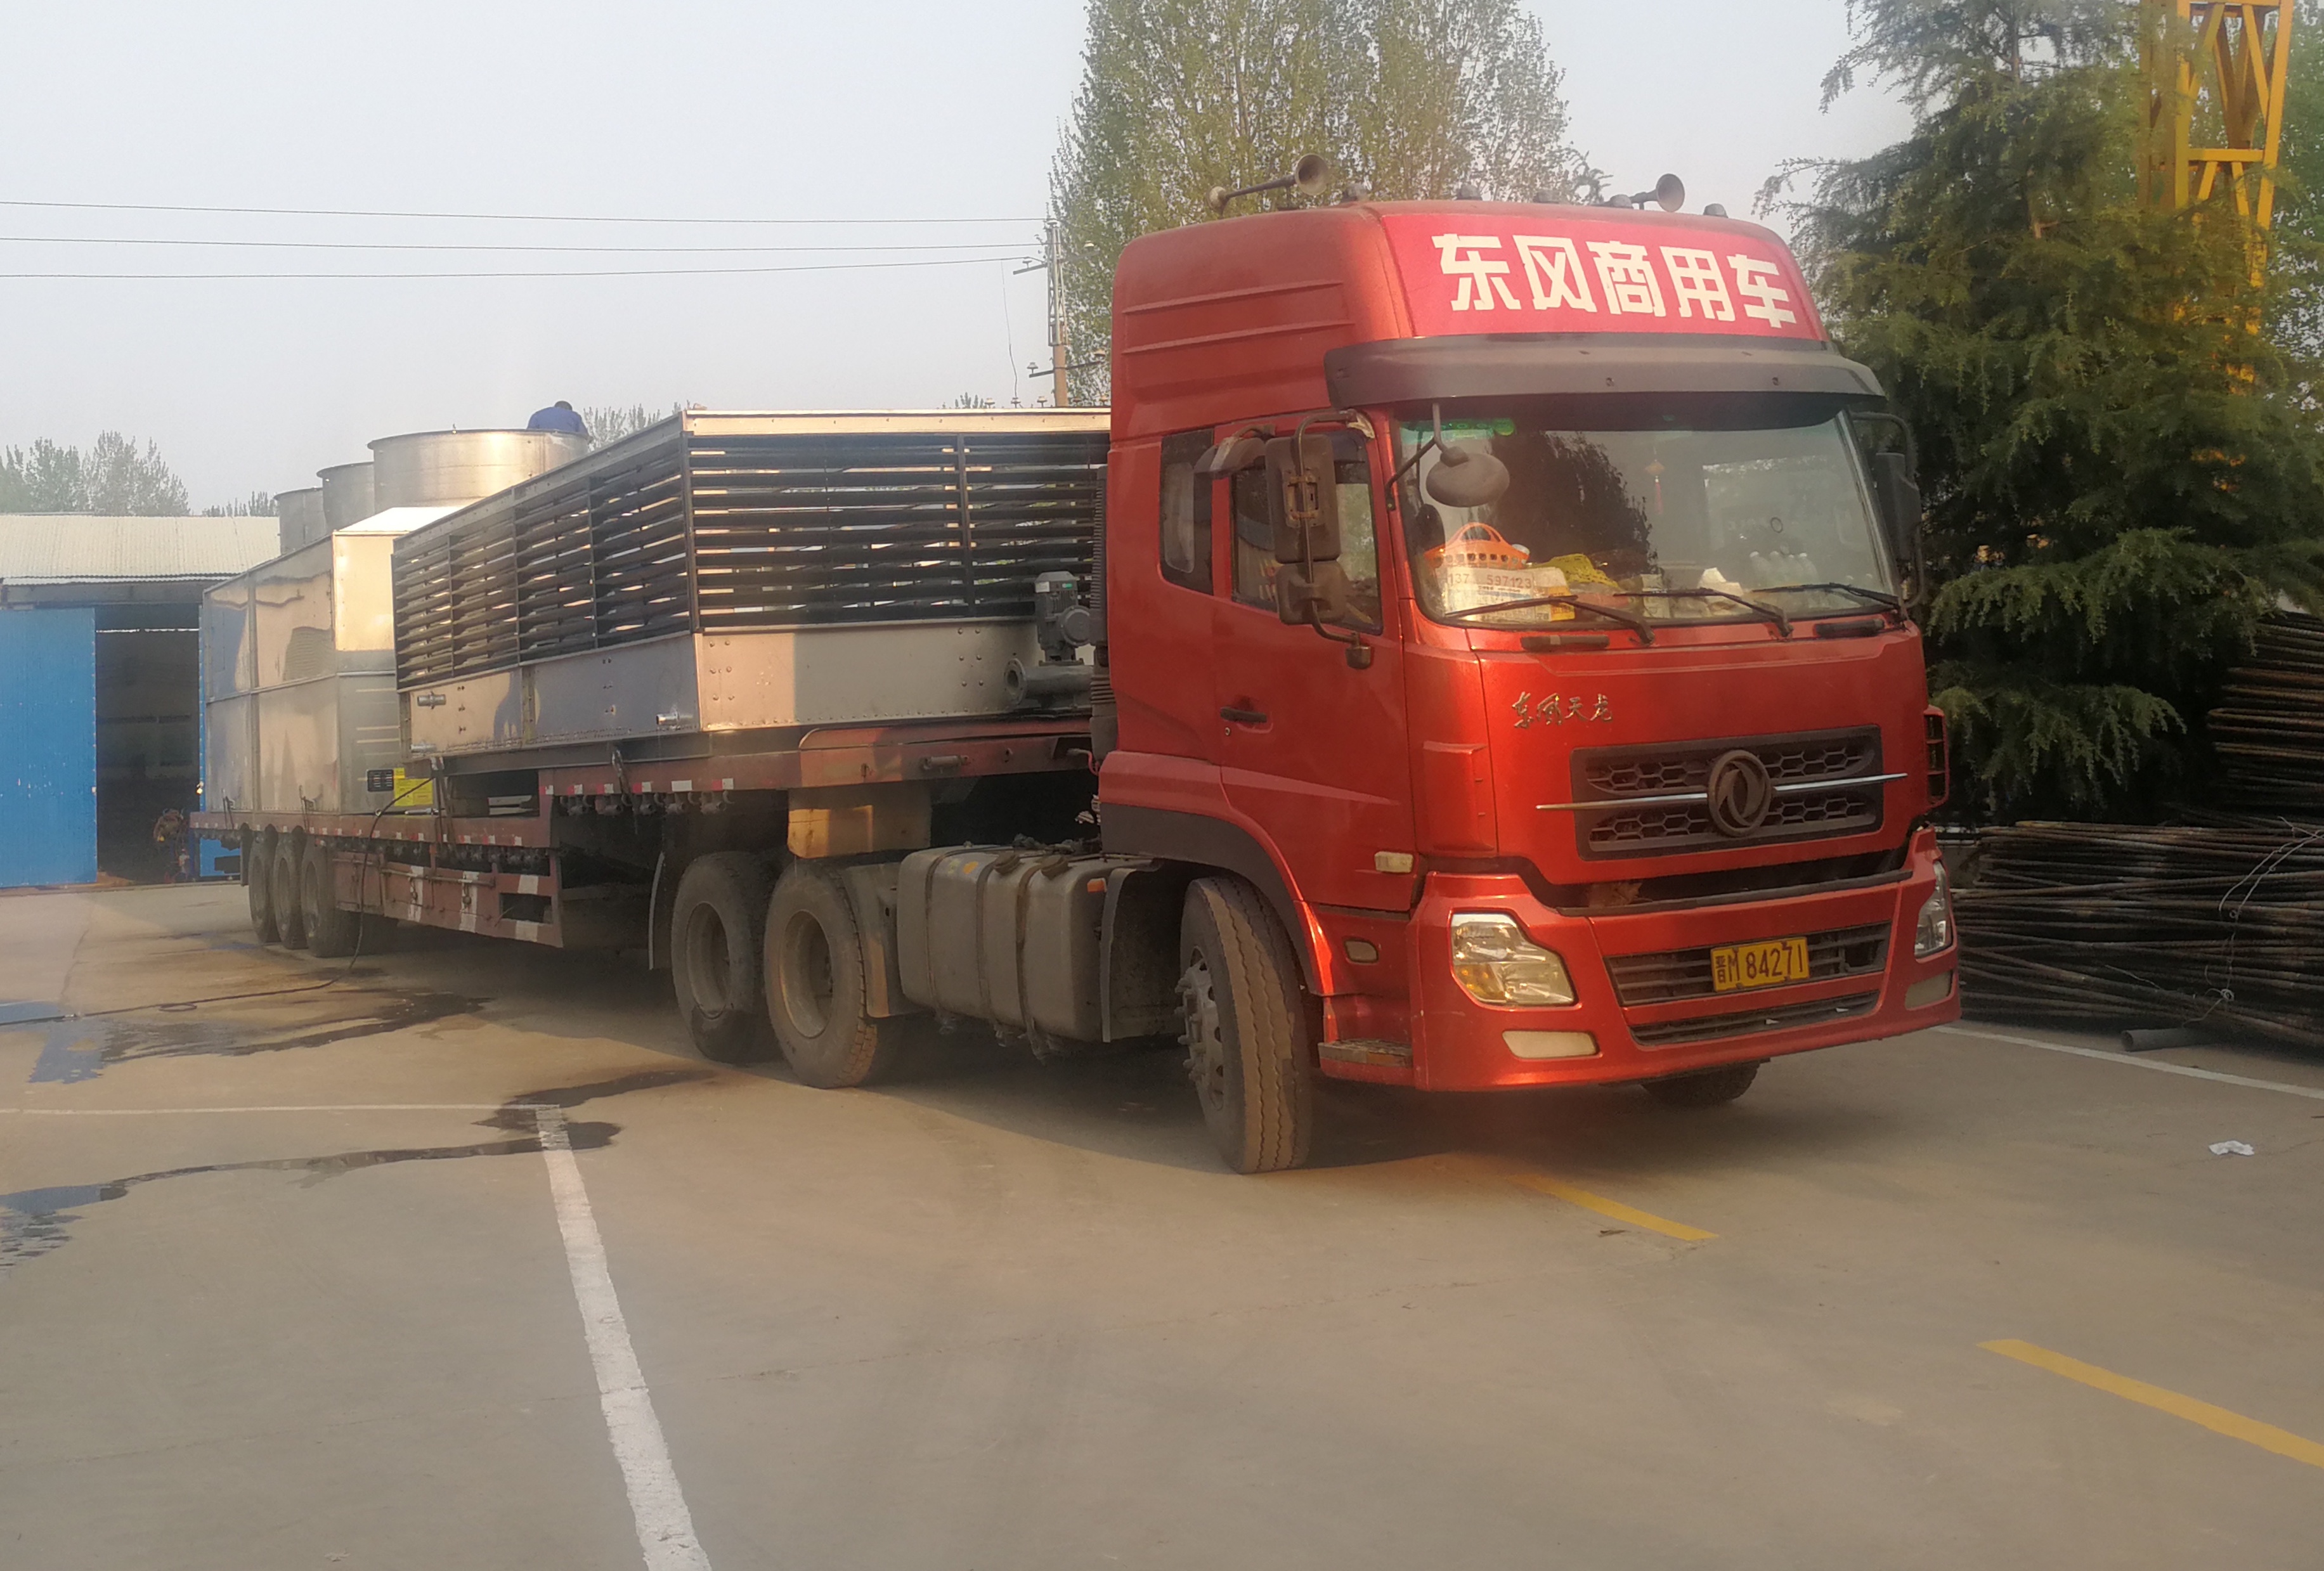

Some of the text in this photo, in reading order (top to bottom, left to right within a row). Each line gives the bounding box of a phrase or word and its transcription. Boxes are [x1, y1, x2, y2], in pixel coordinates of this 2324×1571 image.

[1431, 233, 1797, 328] 东风商用车
[1486, 574, 1531, 589] 597123
